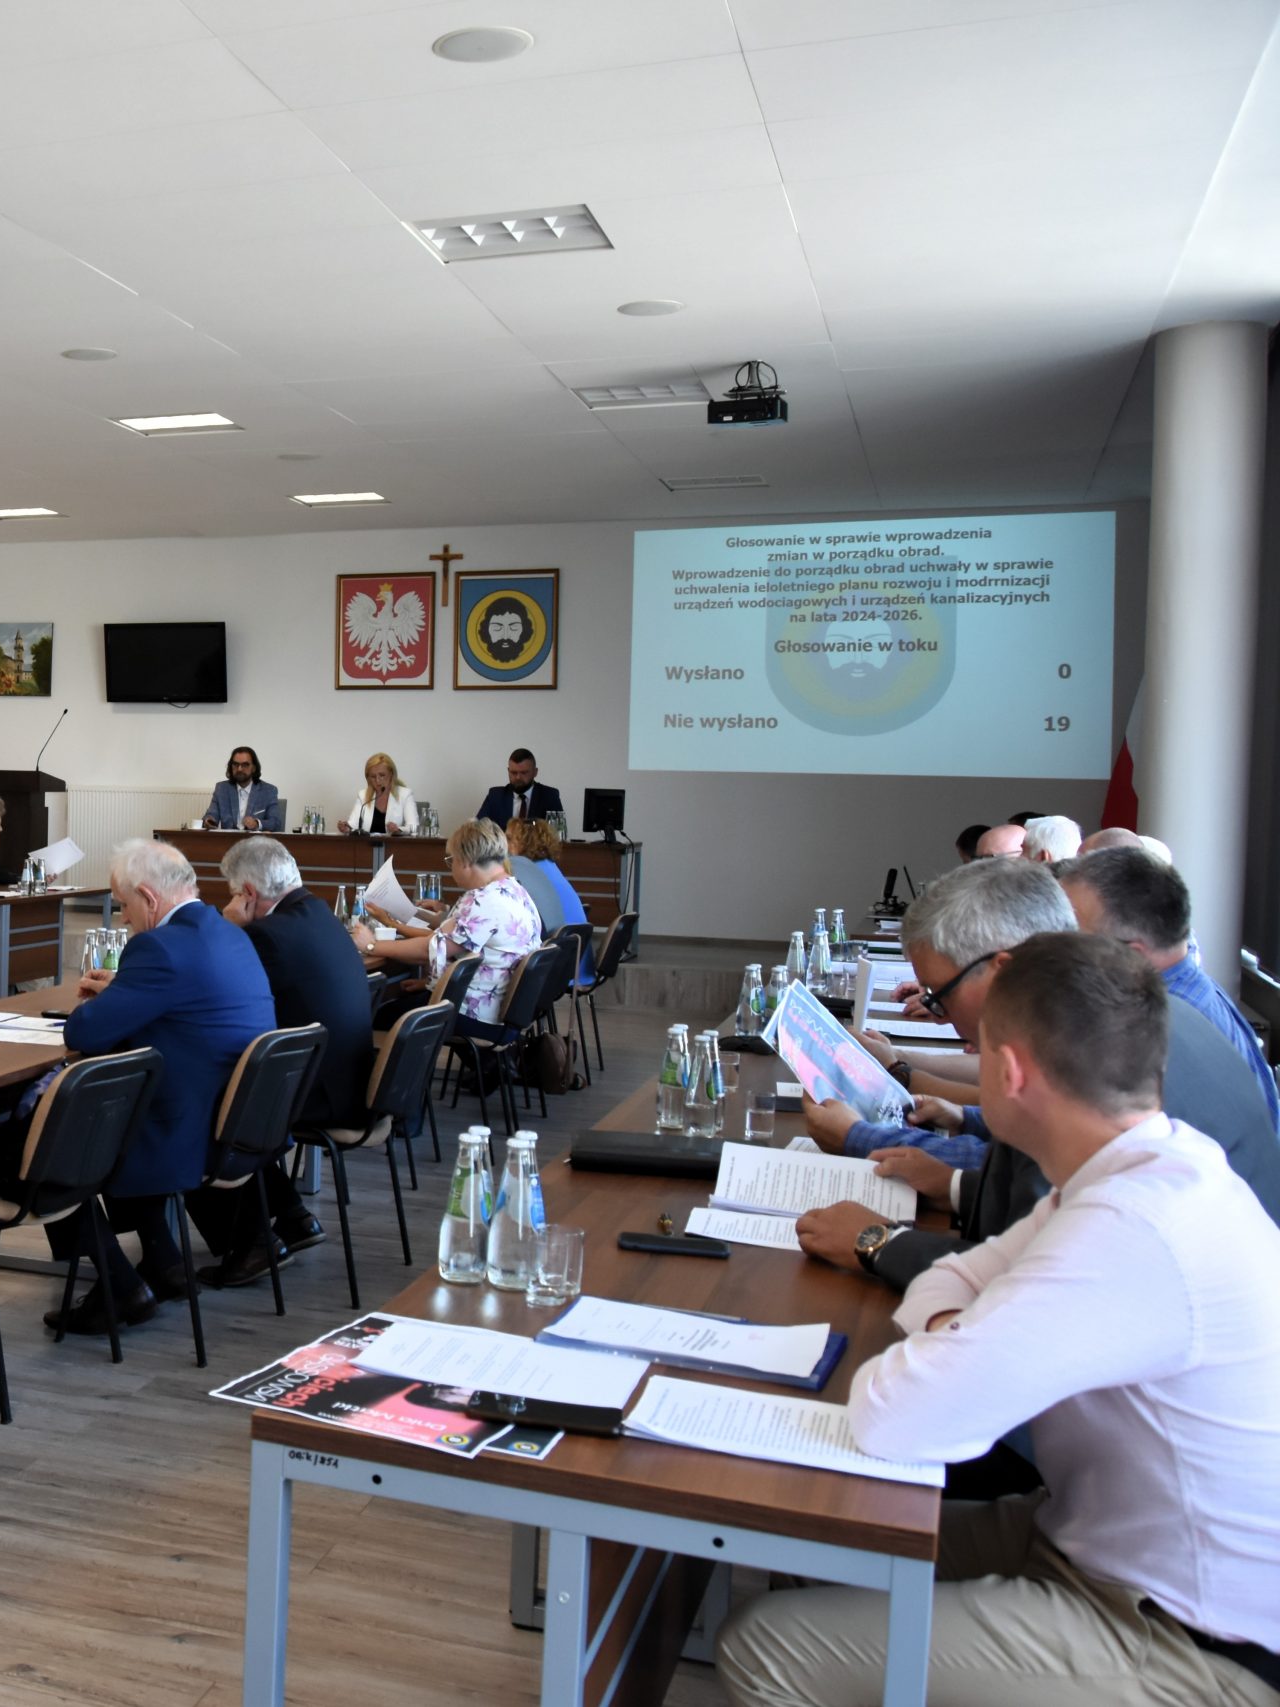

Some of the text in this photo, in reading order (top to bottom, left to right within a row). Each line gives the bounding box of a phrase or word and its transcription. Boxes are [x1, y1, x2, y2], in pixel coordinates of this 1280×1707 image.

[725, 528, 993, 549] Głosowanie w sprawie wprowadzenia
[767, 545, 945, 563] zmian w porządku obrad.
[671, 558, 1054, 582] Wprowadzenie do porządku obrad uchwały w sprawie
[674, 581, 750, 596] uchwalenia
[838, 577, 878, 593] planu
[882, 576, 942, 591] rozwoju
[946, 576, 951, 588] i
[673, 597, 734, 612] urządzeń
[851, 595, 856, 606] i
[860, 592, 926, 608] urządzeń
[930, 590, 1050, 606] kanalizacyjnych
[789, 609, 923, 624] na lata 2024-2026.
[773, 638, 938, 653] Głosowanie w toku
[664, 664, 745, 684] Wysłano
[1057, 663, 1072, 680] 0
[663, 713, 779, 732] Nie wysłano
[1044, 715, 1071, 732] 19
